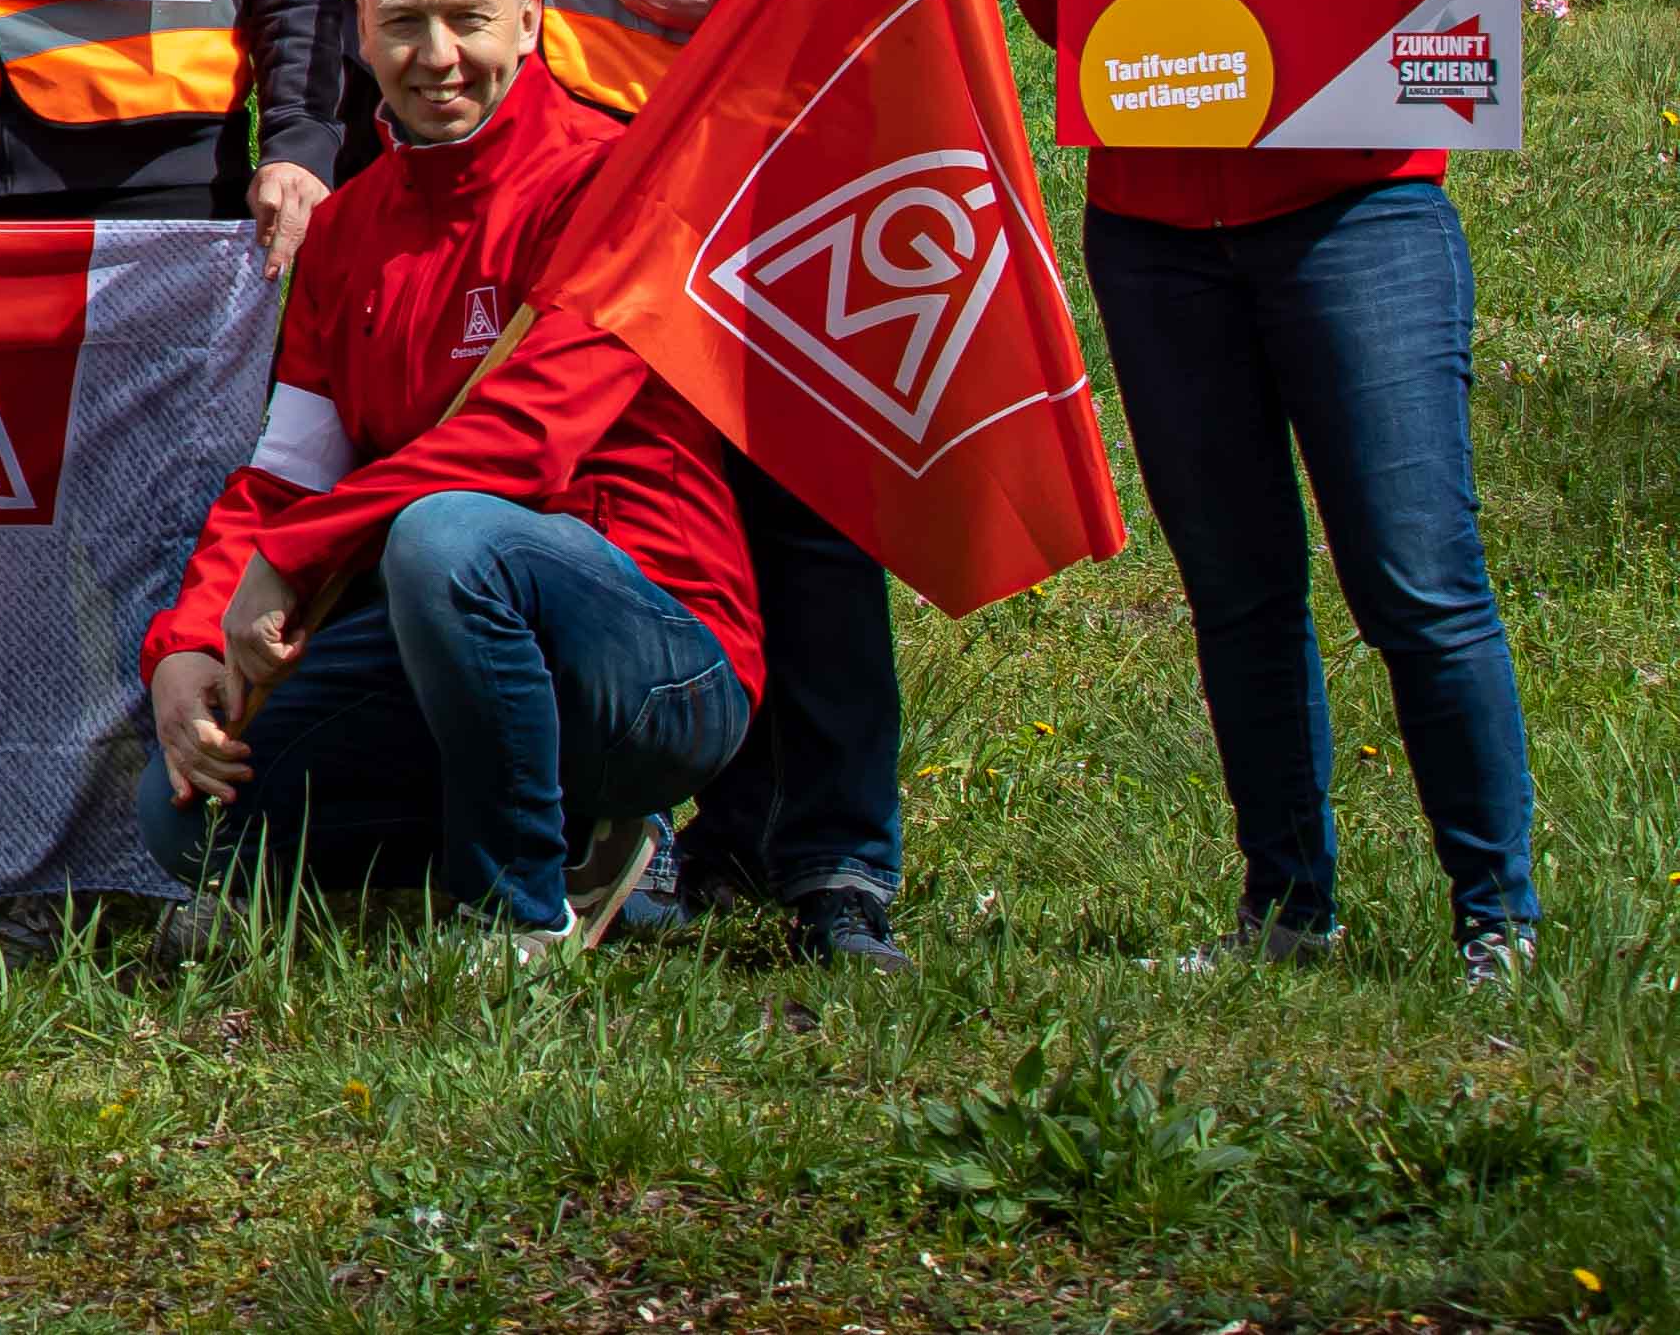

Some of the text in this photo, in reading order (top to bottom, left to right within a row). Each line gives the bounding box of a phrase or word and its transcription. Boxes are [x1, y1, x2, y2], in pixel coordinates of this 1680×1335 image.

[1396, 36, 1486, 56] ZUKUNFT
[1105, 51, 1247, 82] Tarifvertrag
[1401, 61, 1494, 82] SICHERN.
[1110, 76, 1247, 111] verlängern!
